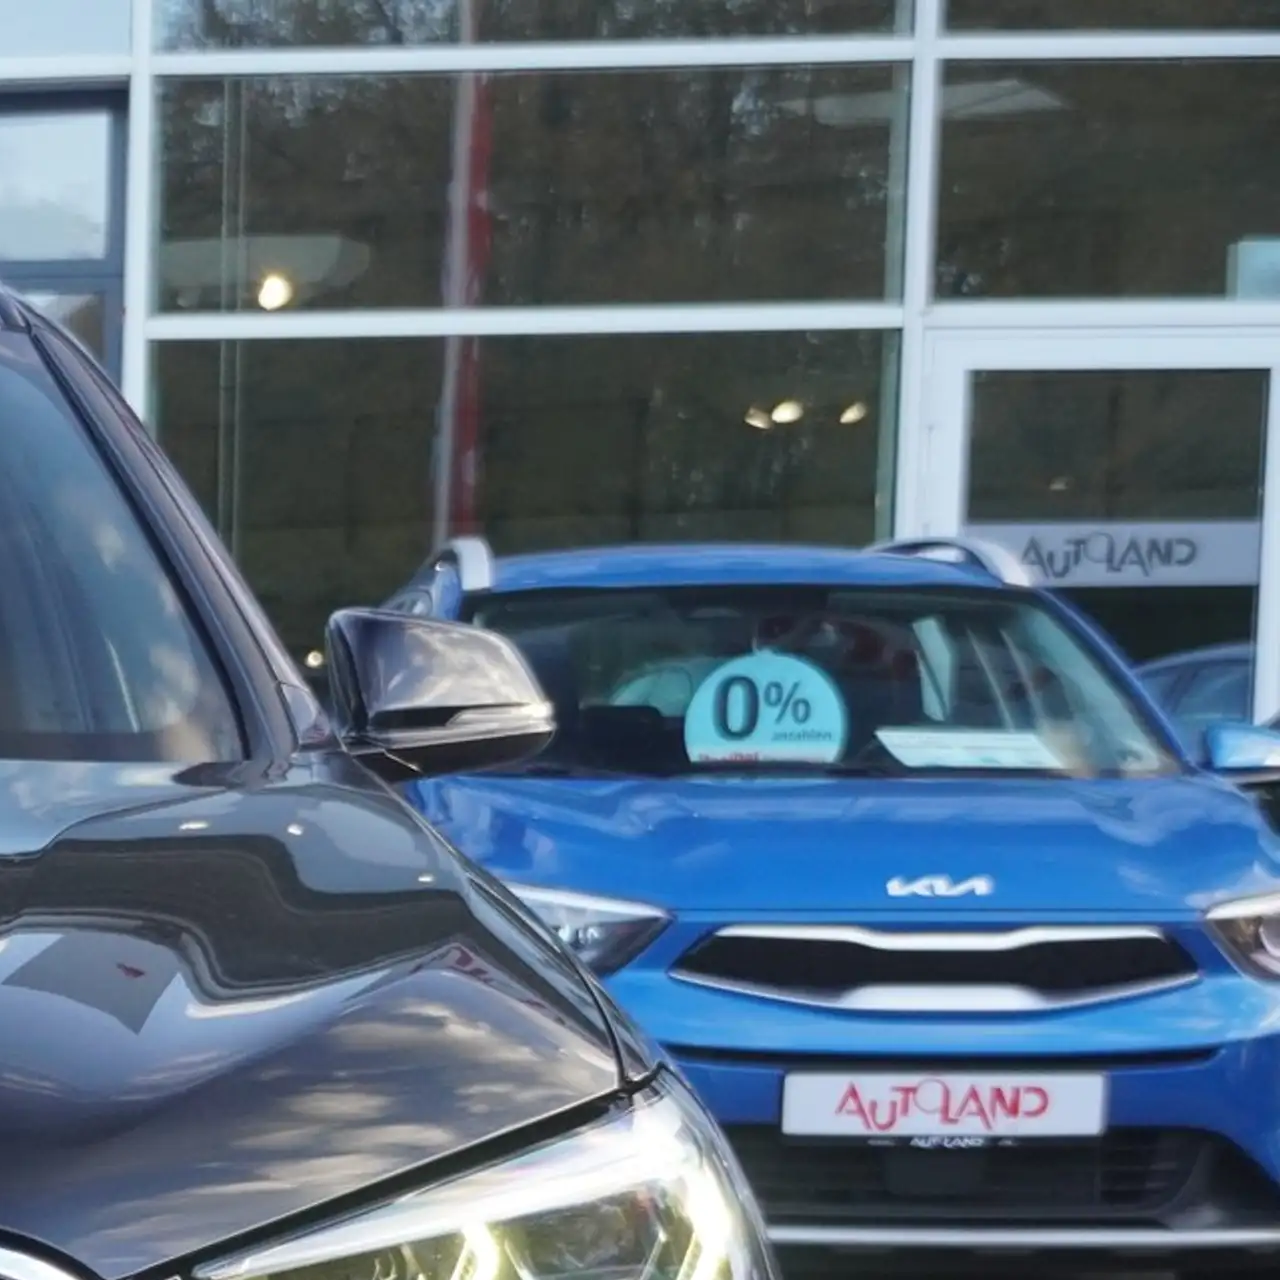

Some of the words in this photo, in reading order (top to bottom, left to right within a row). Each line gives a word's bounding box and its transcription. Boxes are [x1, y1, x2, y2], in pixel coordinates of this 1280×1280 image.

[1021, 531, 1198, 579] AUTOLAND
[834, 1078, 1050, 1132] AUTOLAND
[910, 1136, 984, 1148] AUTLAND
